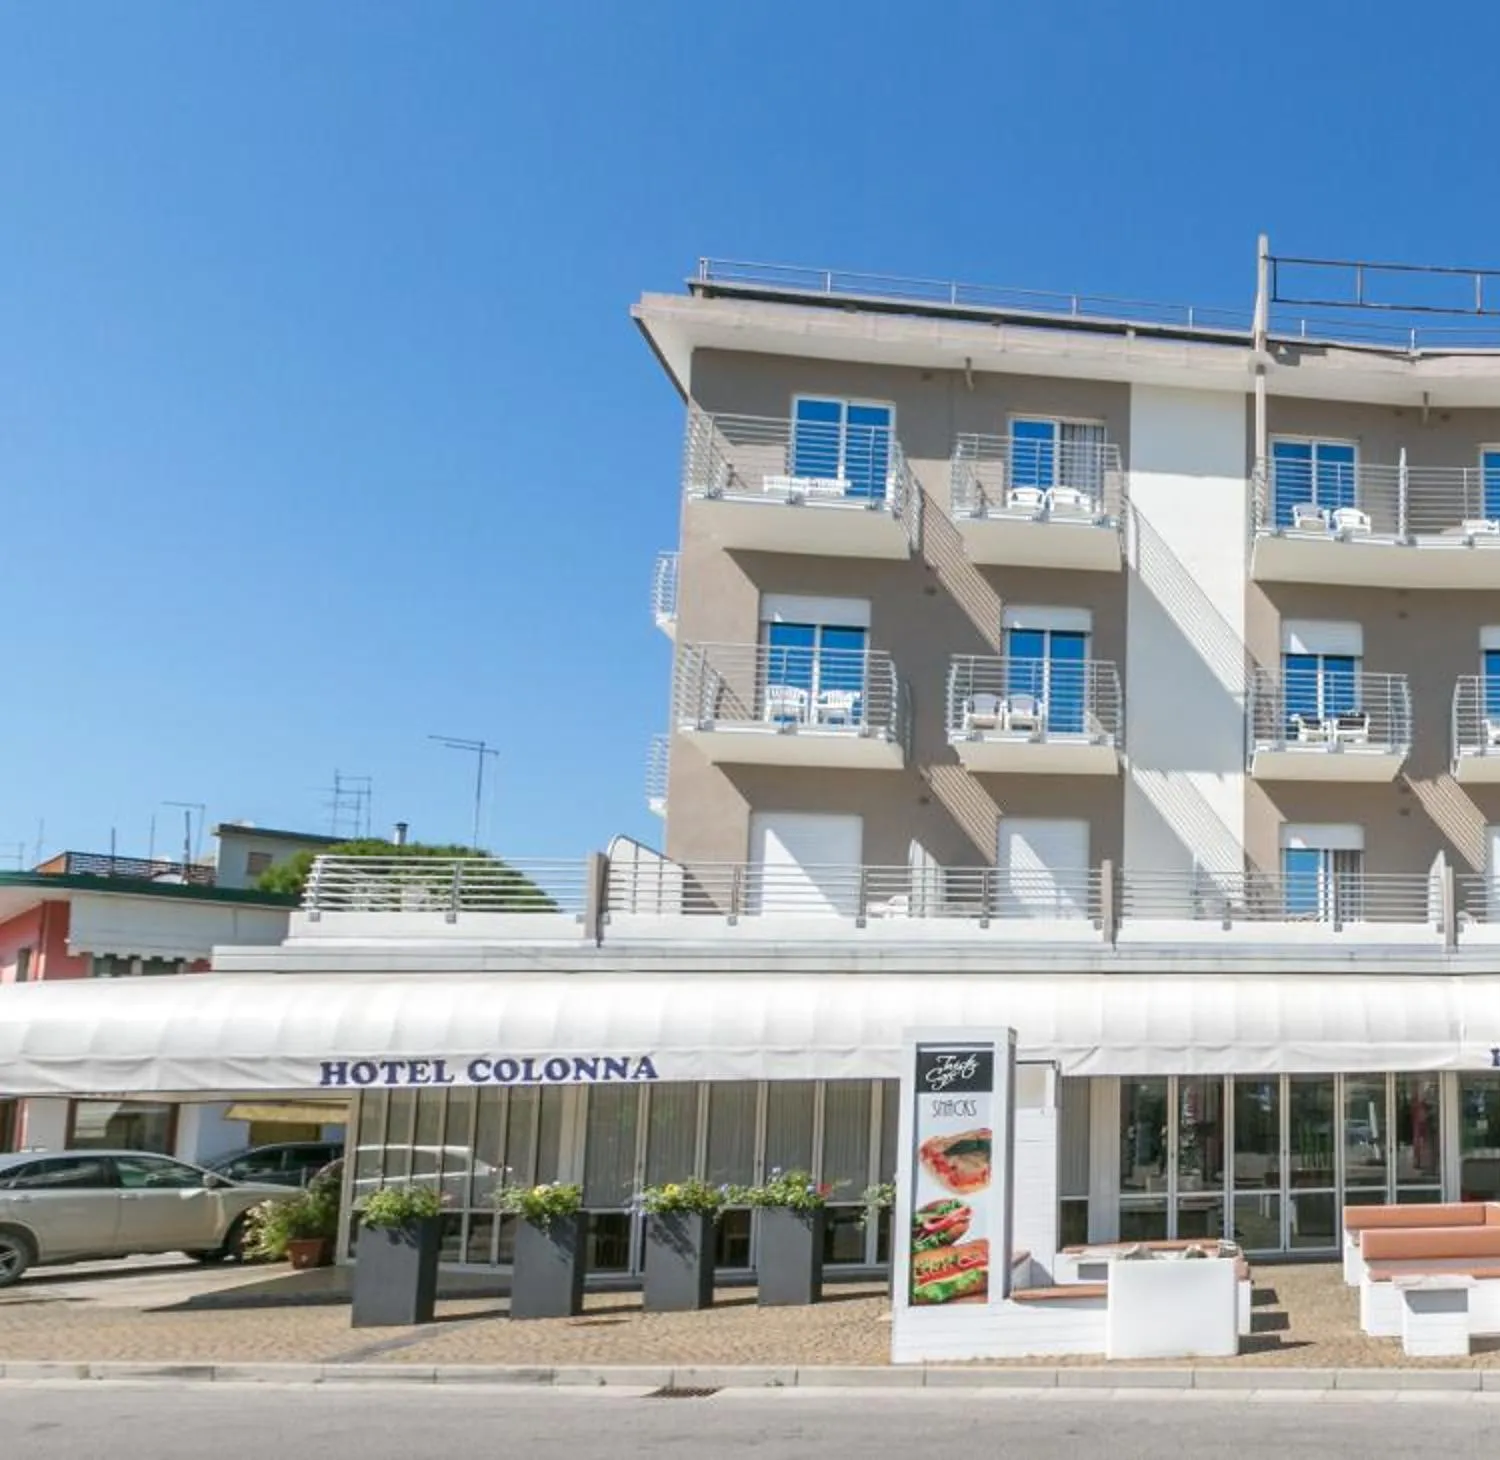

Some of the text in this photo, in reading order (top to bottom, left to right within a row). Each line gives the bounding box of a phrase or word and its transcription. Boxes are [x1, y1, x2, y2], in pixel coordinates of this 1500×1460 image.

[319, 1054, 660, 1086] HOTEL COLONNA
[931, 1099, 978, 1118] SNACKS
